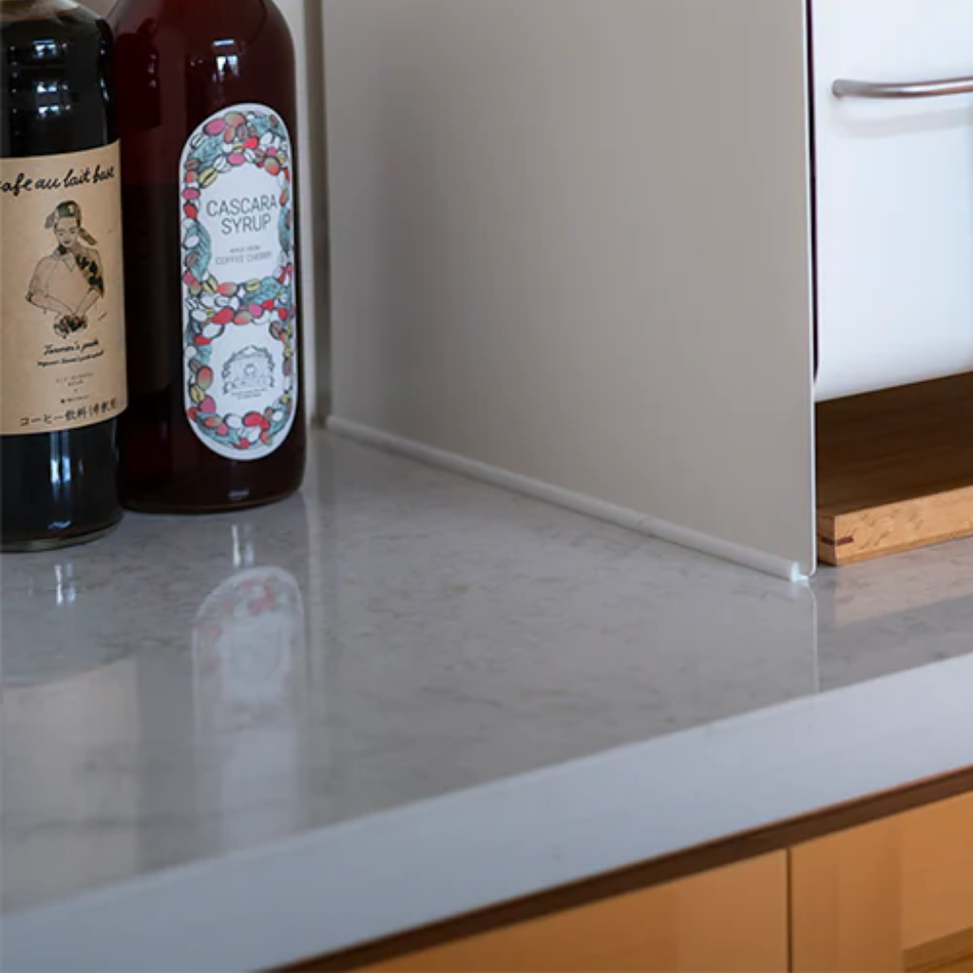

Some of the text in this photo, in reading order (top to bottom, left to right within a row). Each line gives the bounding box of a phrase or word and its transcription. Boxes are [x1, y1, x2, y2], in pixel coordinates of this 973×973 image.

[35, 178, 61, 190] au
[63, 168, 90, 188] lait
[206, 194, 278, 217] CASCARA
[221, 213, 271, 236] SYRUP
